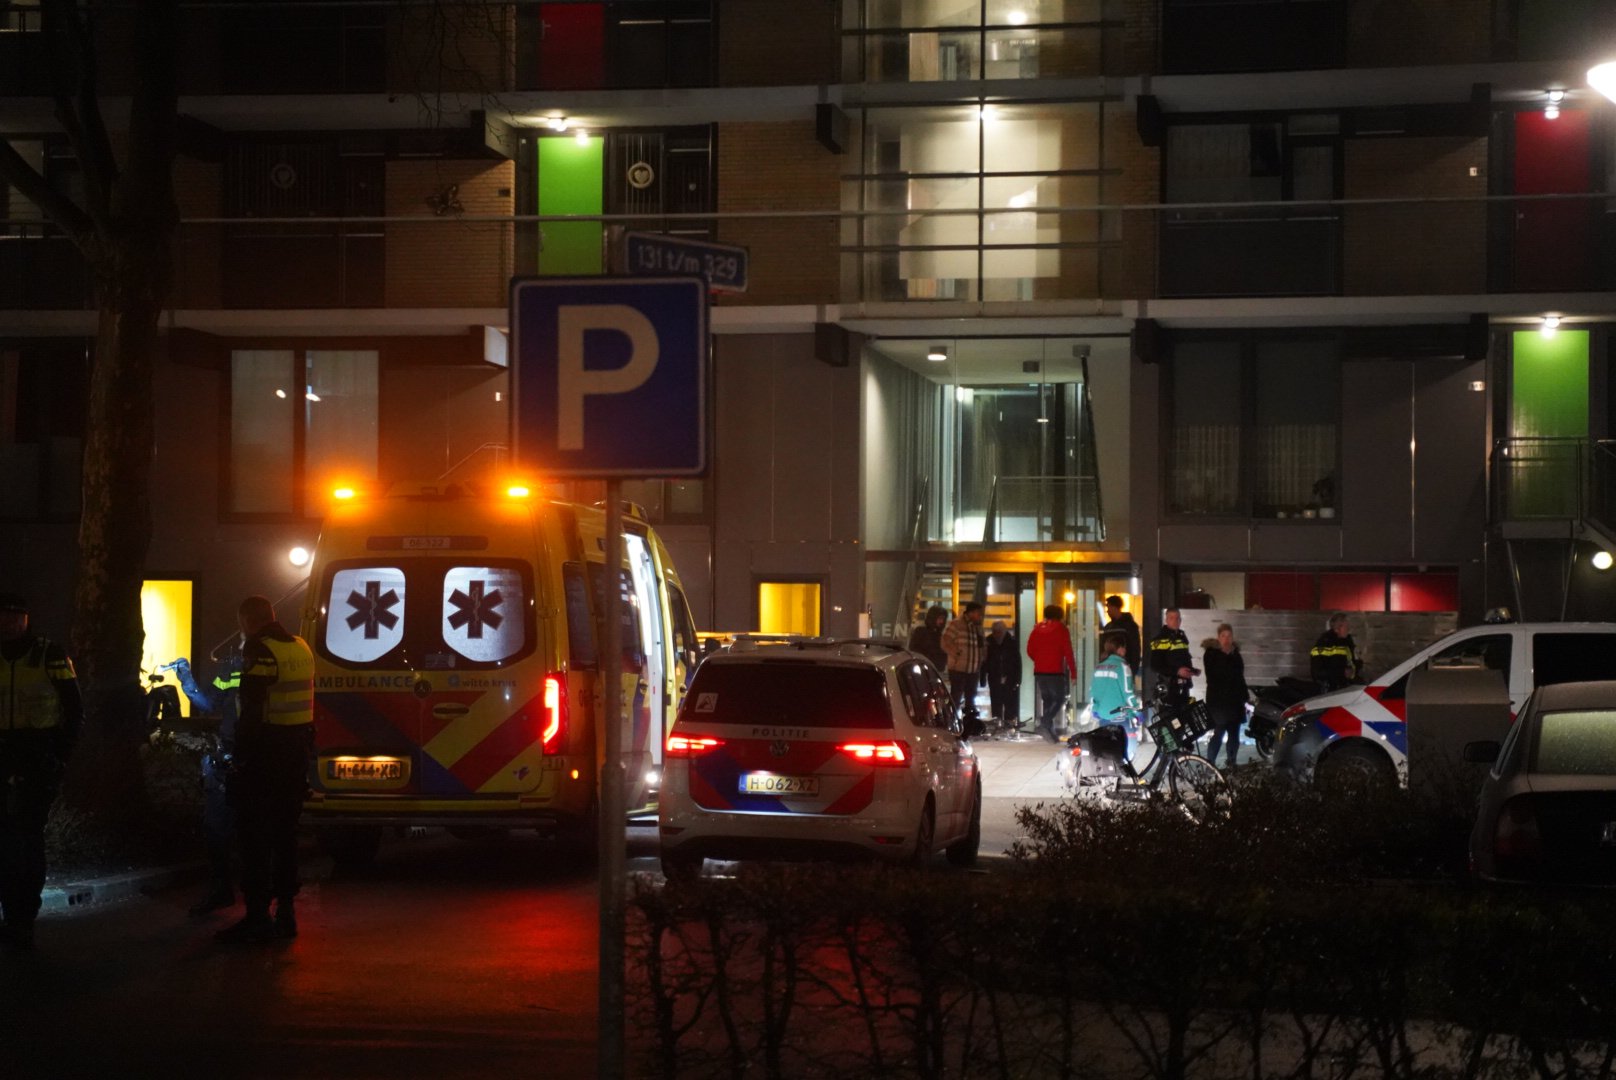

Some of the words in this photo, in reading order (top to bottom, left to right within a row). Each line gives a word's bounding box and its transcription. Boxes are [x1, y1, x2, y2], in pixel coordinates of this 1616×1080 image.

[666, 249, 700, 273] t/m
[704, 253, 738, 280] 329
[558, 304, 660, 450] P
[752, 727, 809, 738] POLITIE
[750, 777, 814, 792] H-062-XZ
